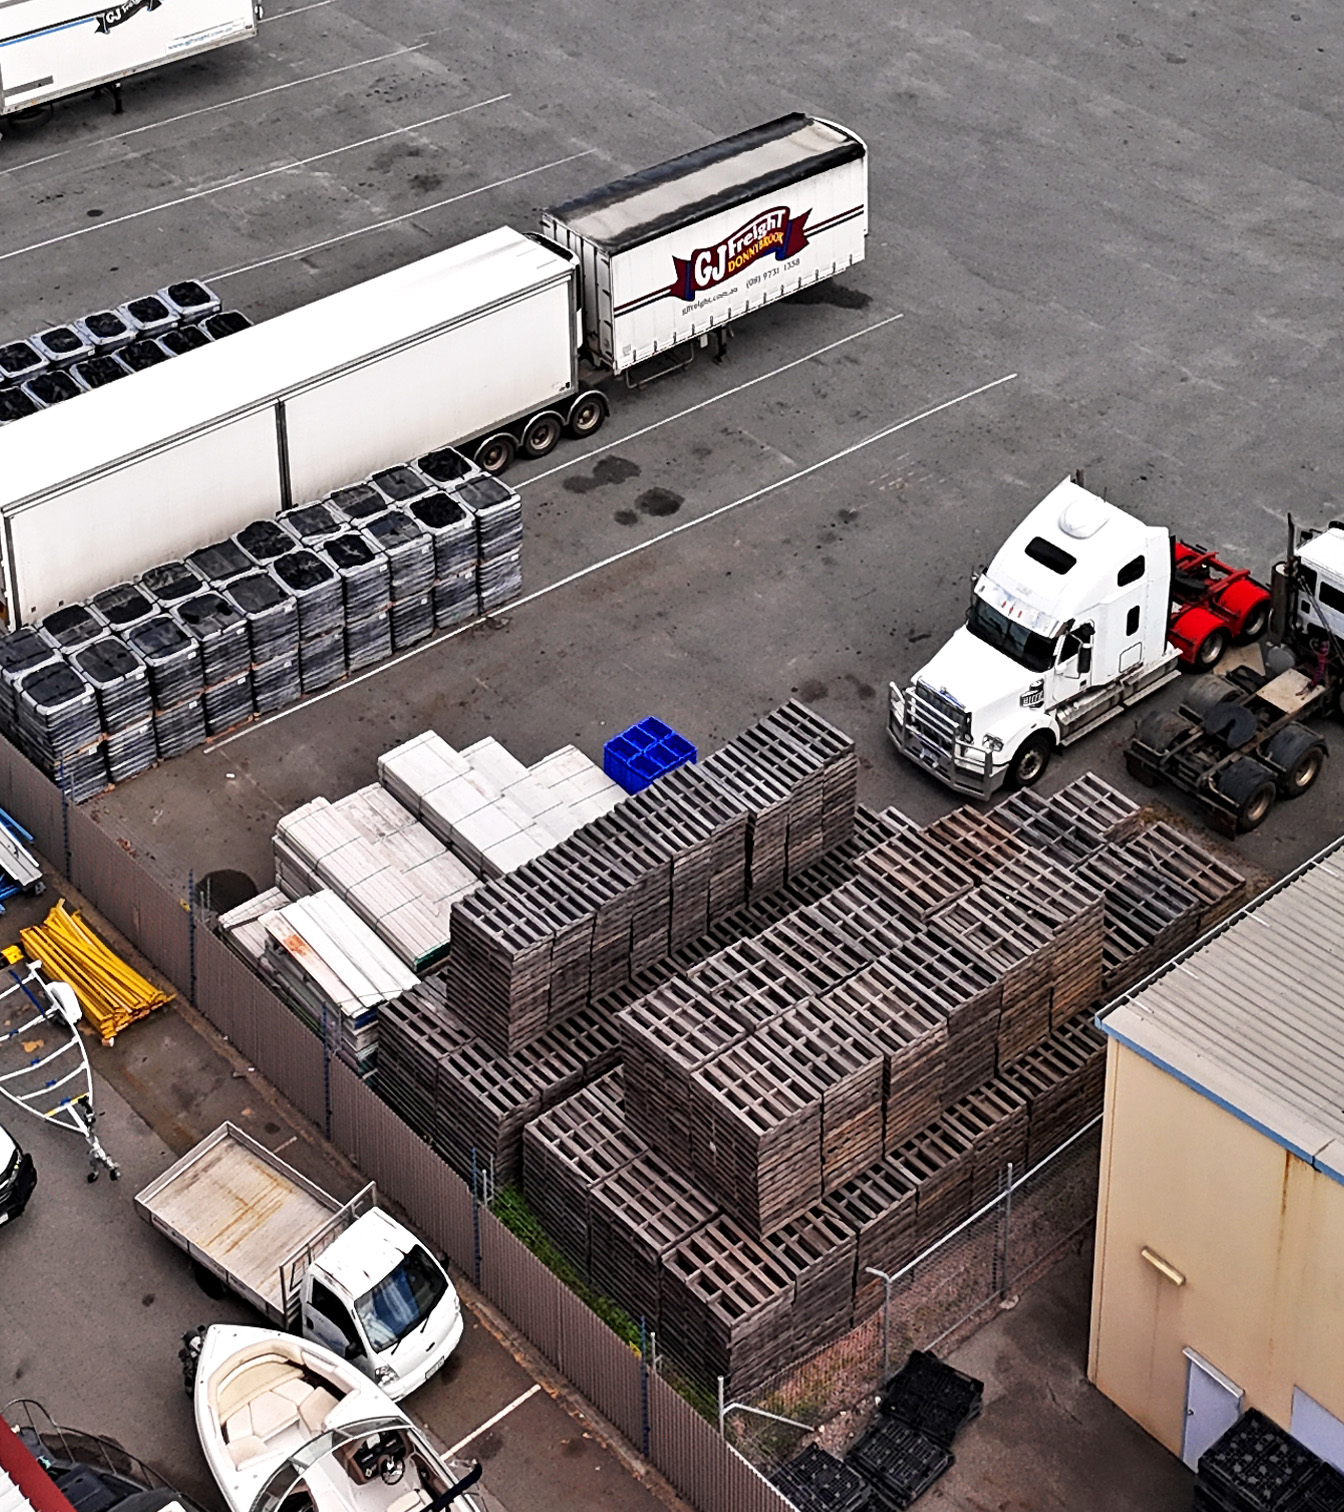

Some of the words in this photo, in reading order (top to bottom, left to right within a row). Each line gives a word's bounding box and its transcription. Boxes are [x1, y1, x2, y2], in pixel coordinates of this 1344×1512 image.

[105, 8, 122, 24] GJ
[694, 243, 727, 287] GJ
[727, 232, 784, 273] DONNYBROOK
